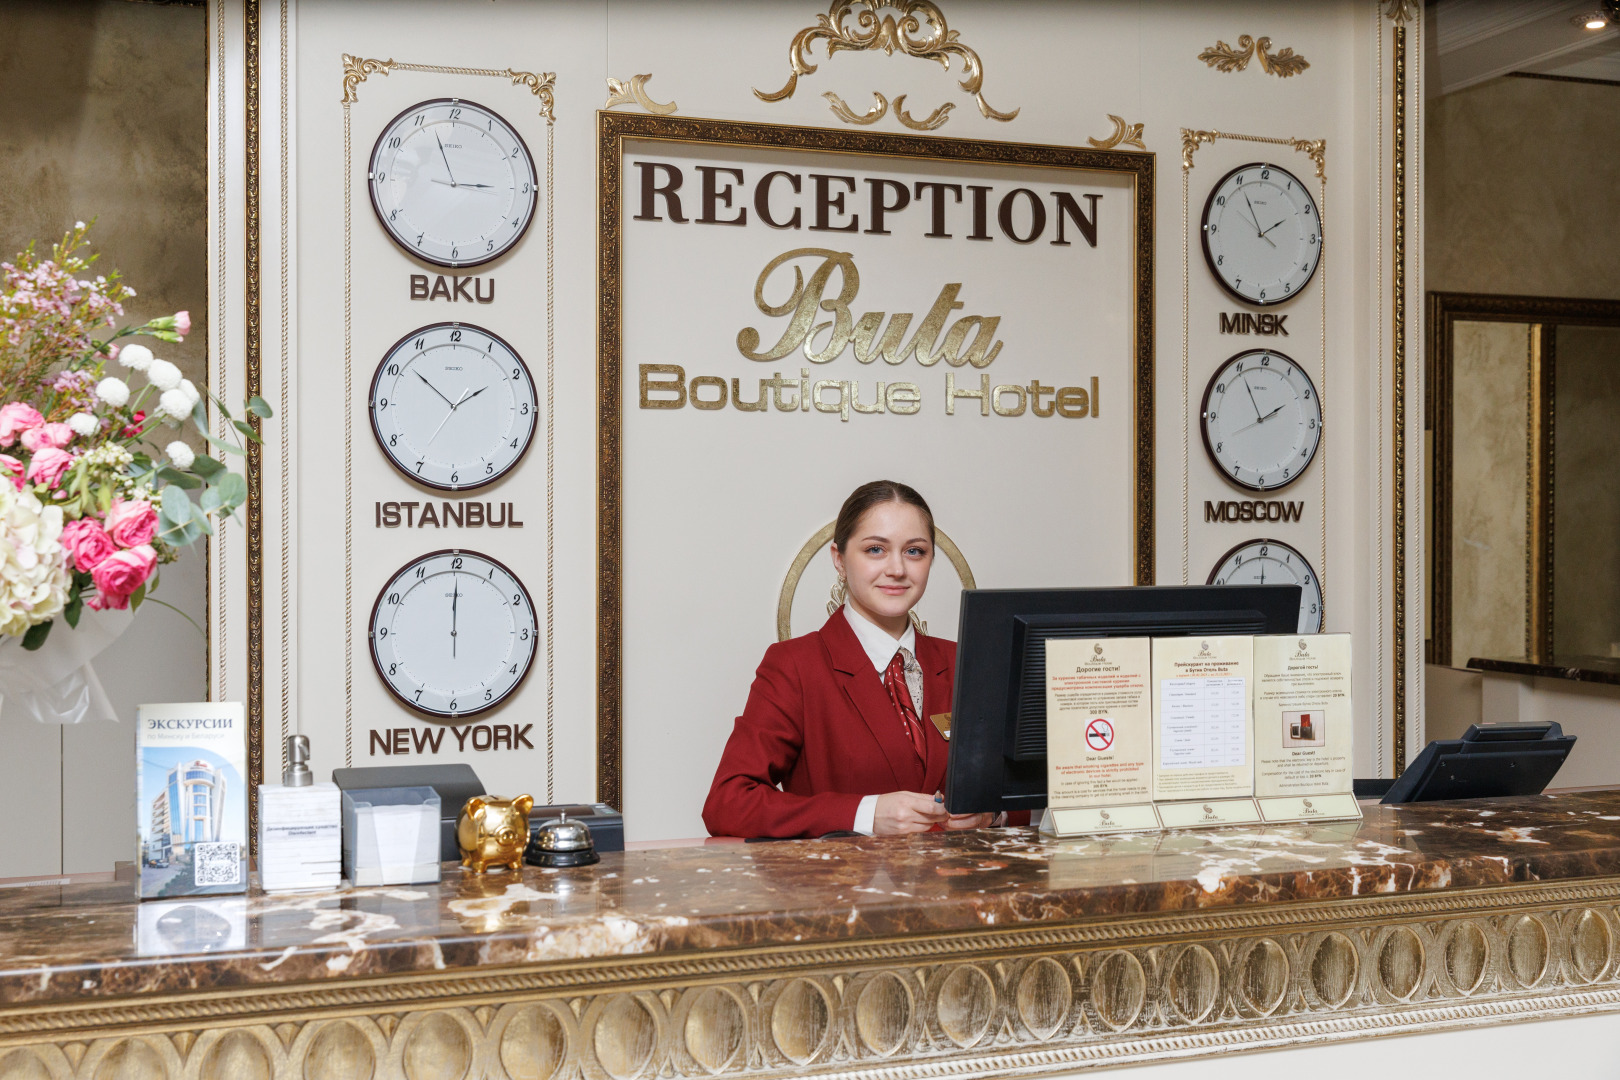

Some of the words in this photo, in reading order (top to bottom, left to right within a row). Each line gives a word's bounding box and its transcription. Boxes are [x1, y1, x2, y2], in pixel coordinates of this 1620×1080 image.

[449, 108, 460, 119] 12
[415, 115, 425, 126] 11
[488, 120, 492, 131] 1
[388, 137, 400, 149] 10
[511, 148, 519, 158] 2
[378, 172, 386, 183] 9
[1236, 175, 1243, 184] 11
[1261, 170, 1269, 180] 12
[522, 183, 529, 194] 3
[1287, 181, 1291, 190] 1
[633, 161, 1103, 248] RECEPTION
[1217, 196, 1225, 206] 10
[1304, 204, 1310, 214] 2
[390, 209, 397, 221] 8
[511, 217, 520, 227] 4
[1211, 225, 1217, 235] 9
[417, 235, 424, 247] 7
[1310, 234, 1316, 244] 3
[487, 240, 494, 251] 5
[452, 247, 458, 259] 6
[1217, 255, 1224, 265] 8
[1302, 263, 1308, 272] 4
[410, 274, 495, 304] BAKU
[1236, 279, 1241, 289] 7
[1284, 283, 1290, 292] 5
[1260, 289, 1266, 298] 6
[736, 247, 1003, 369] Buta
[1219, 313, 1289, 336] MINSK
[450, 331, 461, 342] 12
[415, 338, 424, 349] 11
[488, 342, 493, 353] 1
[1236, 362, 1243, 372] 11
[1261, 357, 1270, 366] 12
[387, 365, 399, 376] 10
[513, 369, 520, 380] 2
[1287, 367, 1291, 376] 1
[638, 364, 921, 422] Boutique
[945, 371, 1099, 418] Hotel
[1216, 383, 1225, 393] 10
[1304, 389, 1310, 399] 2
[380, 398, 388, 411] 9
[520, 403, 529, 415] 3
[1210, 412, 1216, 422] 9
[1309, 419, 1315, 429] 3
[390, 435, 397, 446] 8
[510, 438, 518, 449] 4
[1217, 442, 1223, 453] 8
[1301, 448, 1307, 457] 4
[416, 462, 424, 473] 7
[486, 463, 493, 474] 5
[1234, 466, 1240, 476] 7
[451, 471, 458, 483] 6
[1283, 469, 1289, 478] 5
[1258, 475, 1265, 485] 6
[375, 502, 523, 528] ISTANBUL
[1204, 501, 1304, 523] MOSCOW
[1260, 546, 1268, 556] 12
[451, 558, 463, 569] 12
[1235, 555, 1242, 565] 11
[1286, 553, 1290, 563] 1
[416, 567, 425, 578] 11
[489, 568, 494, 579] 1
[1304, 575, 1310, 584] 2
[387, 593, 400, 605] 10
[513, 595, 520, 605] 2
[1311, 604, 1316, 614] 3
[380, 628, 387, 640] 9
[520, 629, 528, 640] 3
[389, 663, 396, 675] 8
[509, 663, 517, 675] 4
[415, 690, 423, 701] 7
[484, 689, 492, 701] 5
[450, 698, 457, 710] 6
[148, 718, 232, 729] ЭКСКУРСИИ
[369, 727, 445, 756] NEW
[451, 724, 534, 752] YORK
